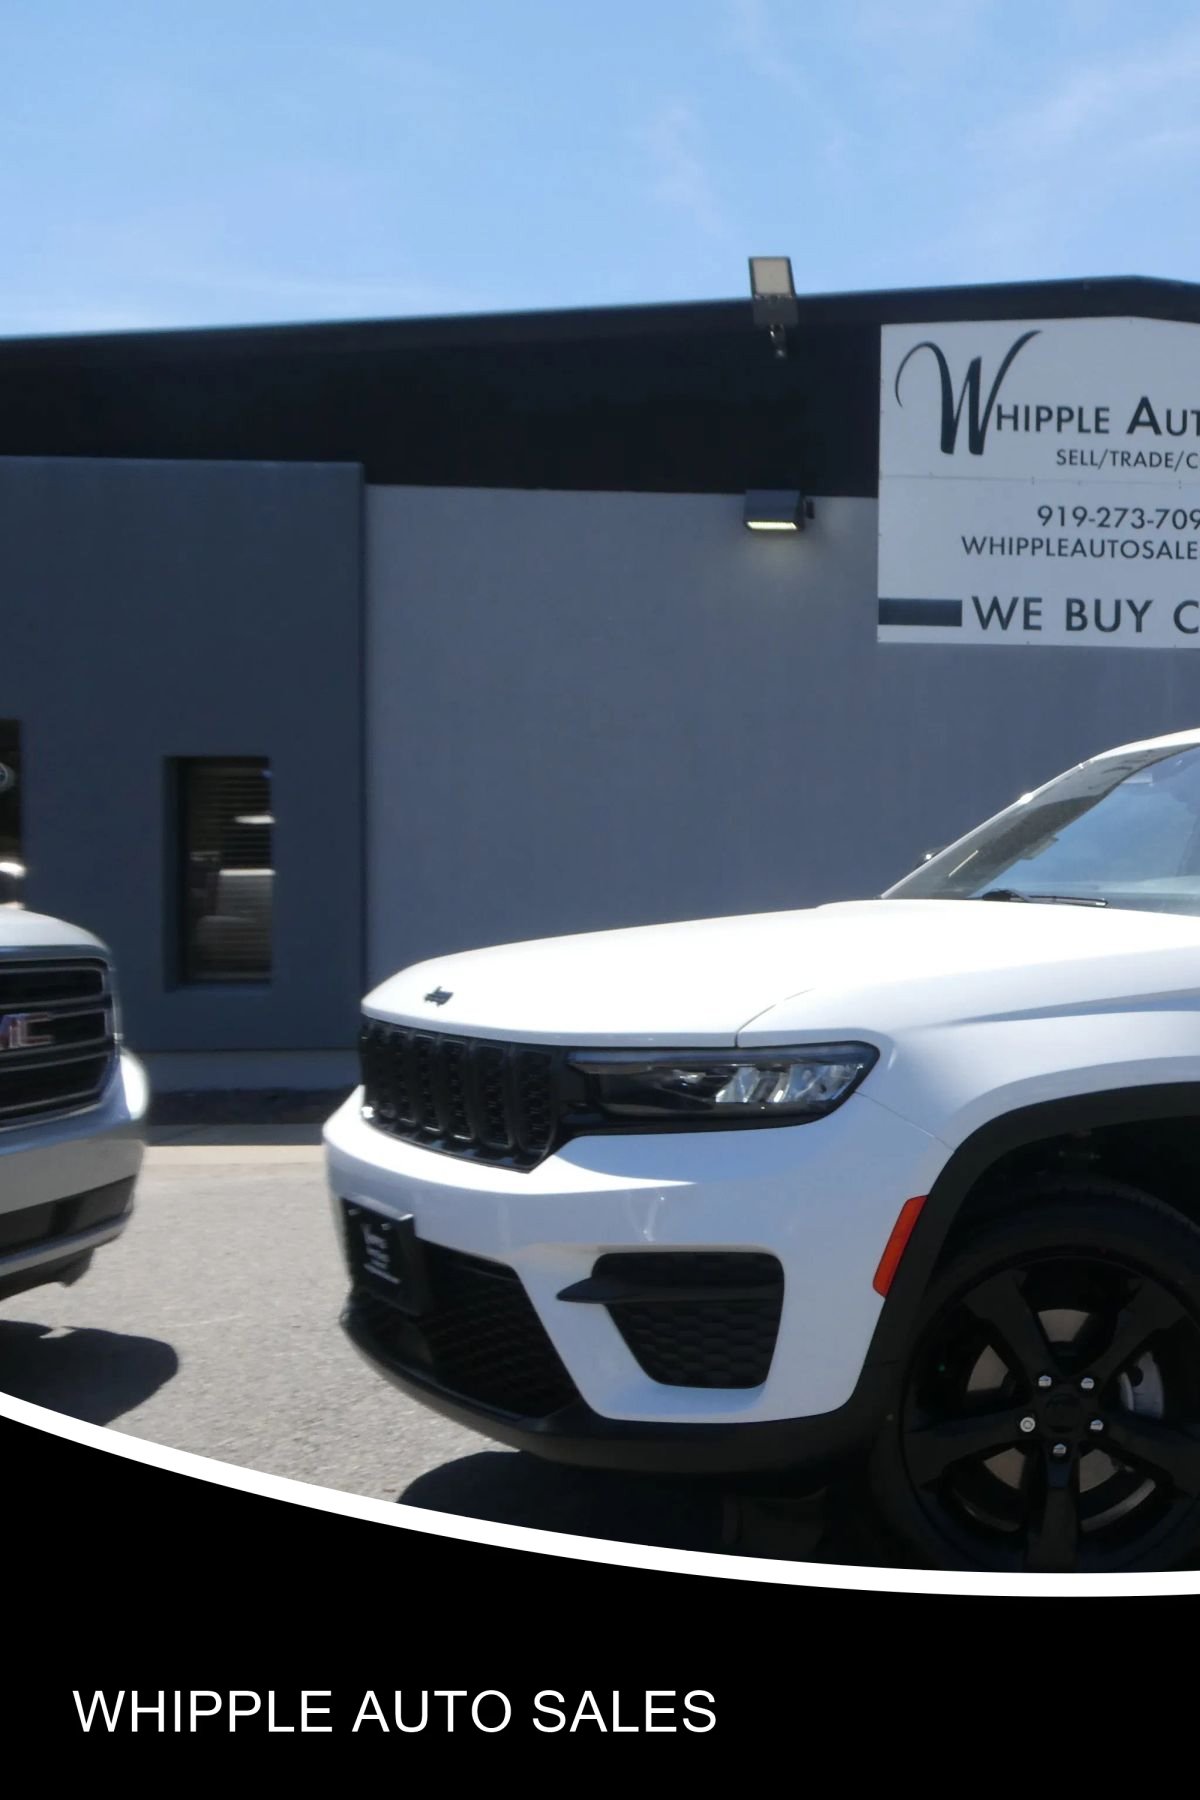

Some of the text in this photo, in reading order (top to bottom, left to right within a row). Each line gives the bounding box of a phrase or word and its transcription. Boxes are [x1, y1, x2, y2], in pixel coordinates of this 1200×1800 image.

[895, 330, 1110, 455] WHIPPLE
[970, 595, 1043, 631] WE
[1065, 597, 1153, 634] BUY
